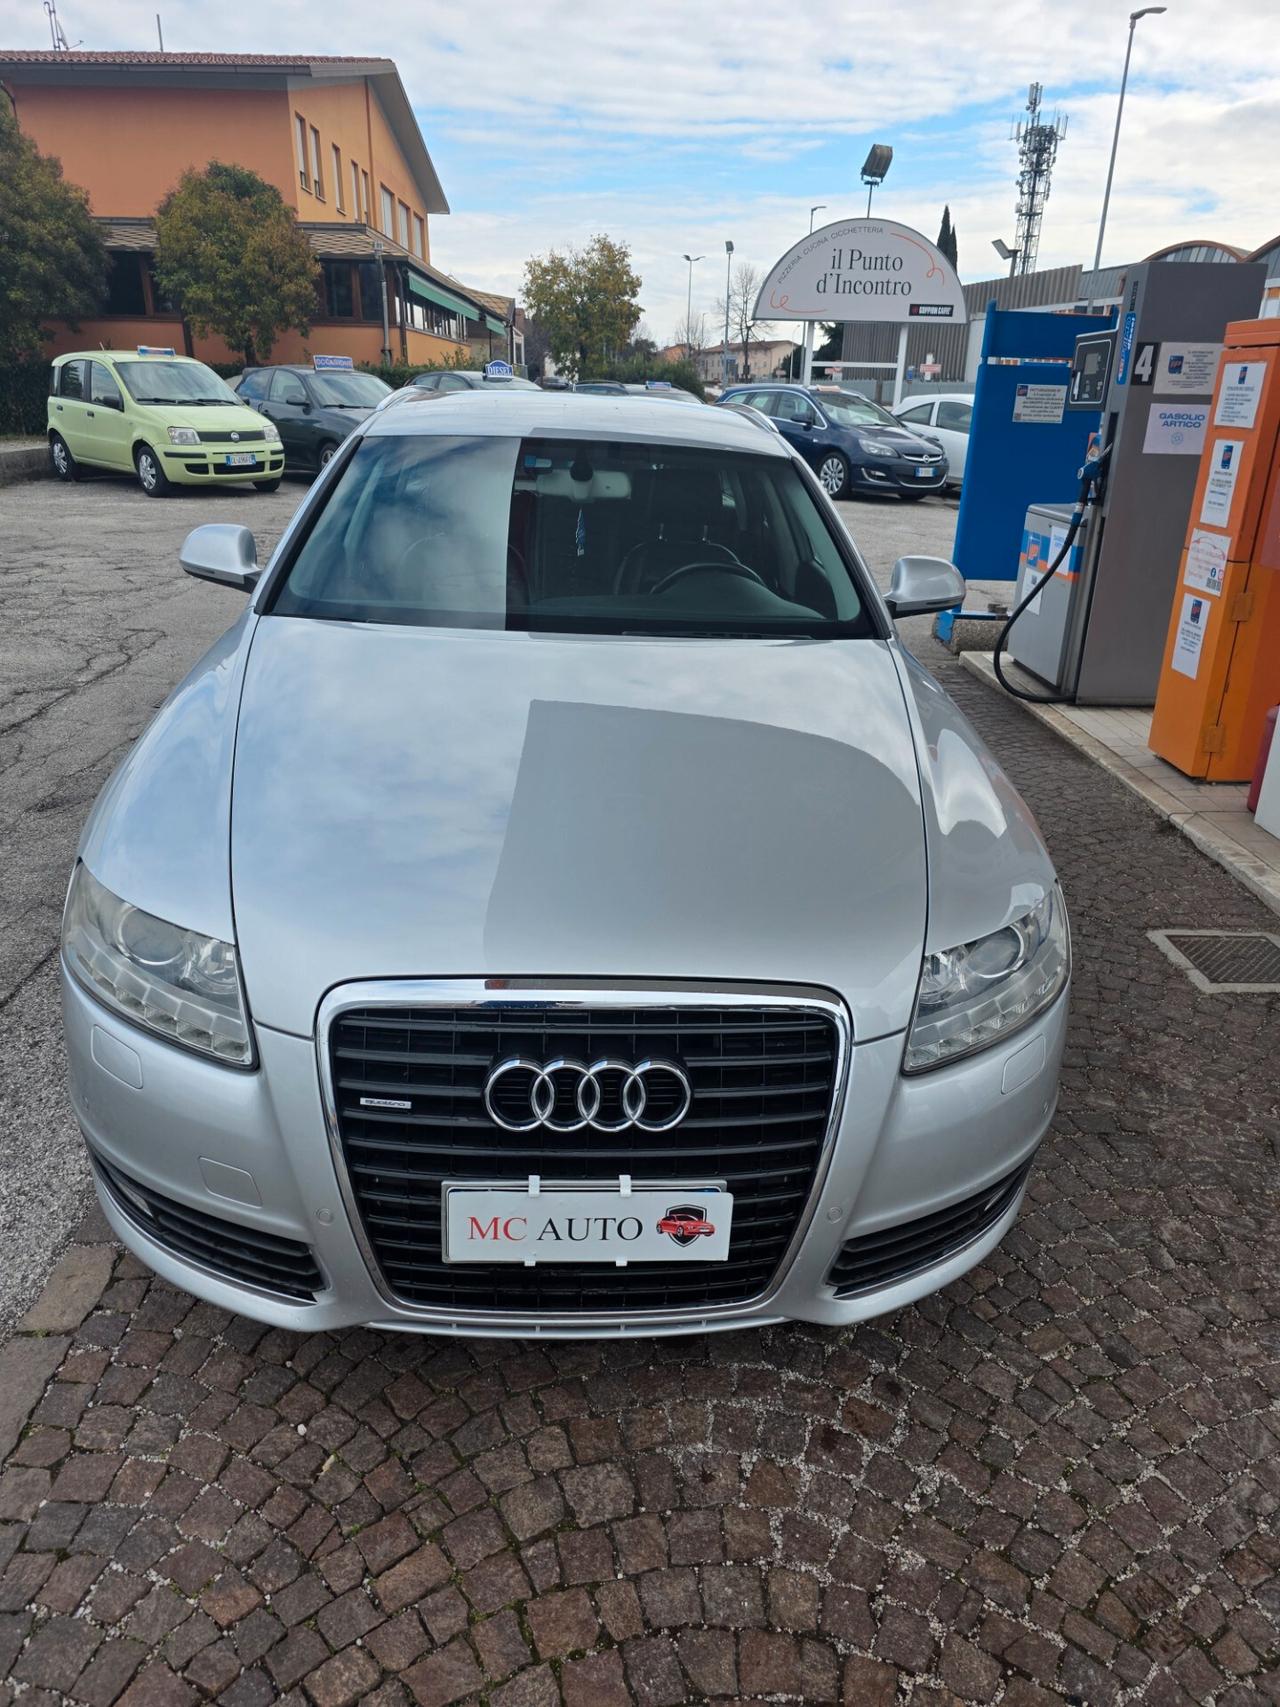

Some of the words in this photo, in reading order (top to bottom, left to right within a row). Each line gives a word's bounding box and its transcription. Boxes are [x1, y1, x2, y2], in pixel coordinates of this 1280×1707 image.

[778, 255, 803, 284] PIZZERIA
[803, 237, 829, 255] CUCINA
[831, 226, 884, 240] CICCHETTERIA
[831, 248, 842, 270] il
[849, 249, 903, 271] Punto
[816, 273, 912, 296] d'Incontro
[488, 365, 512, 376] DIESEL
[1135, 345, 1154, 382] 4
[1160, 413, 1205, 421] GASOLIO
[467, 1216, 527, 1241] MC
[536, 1217, 643, 1241] AUTO
